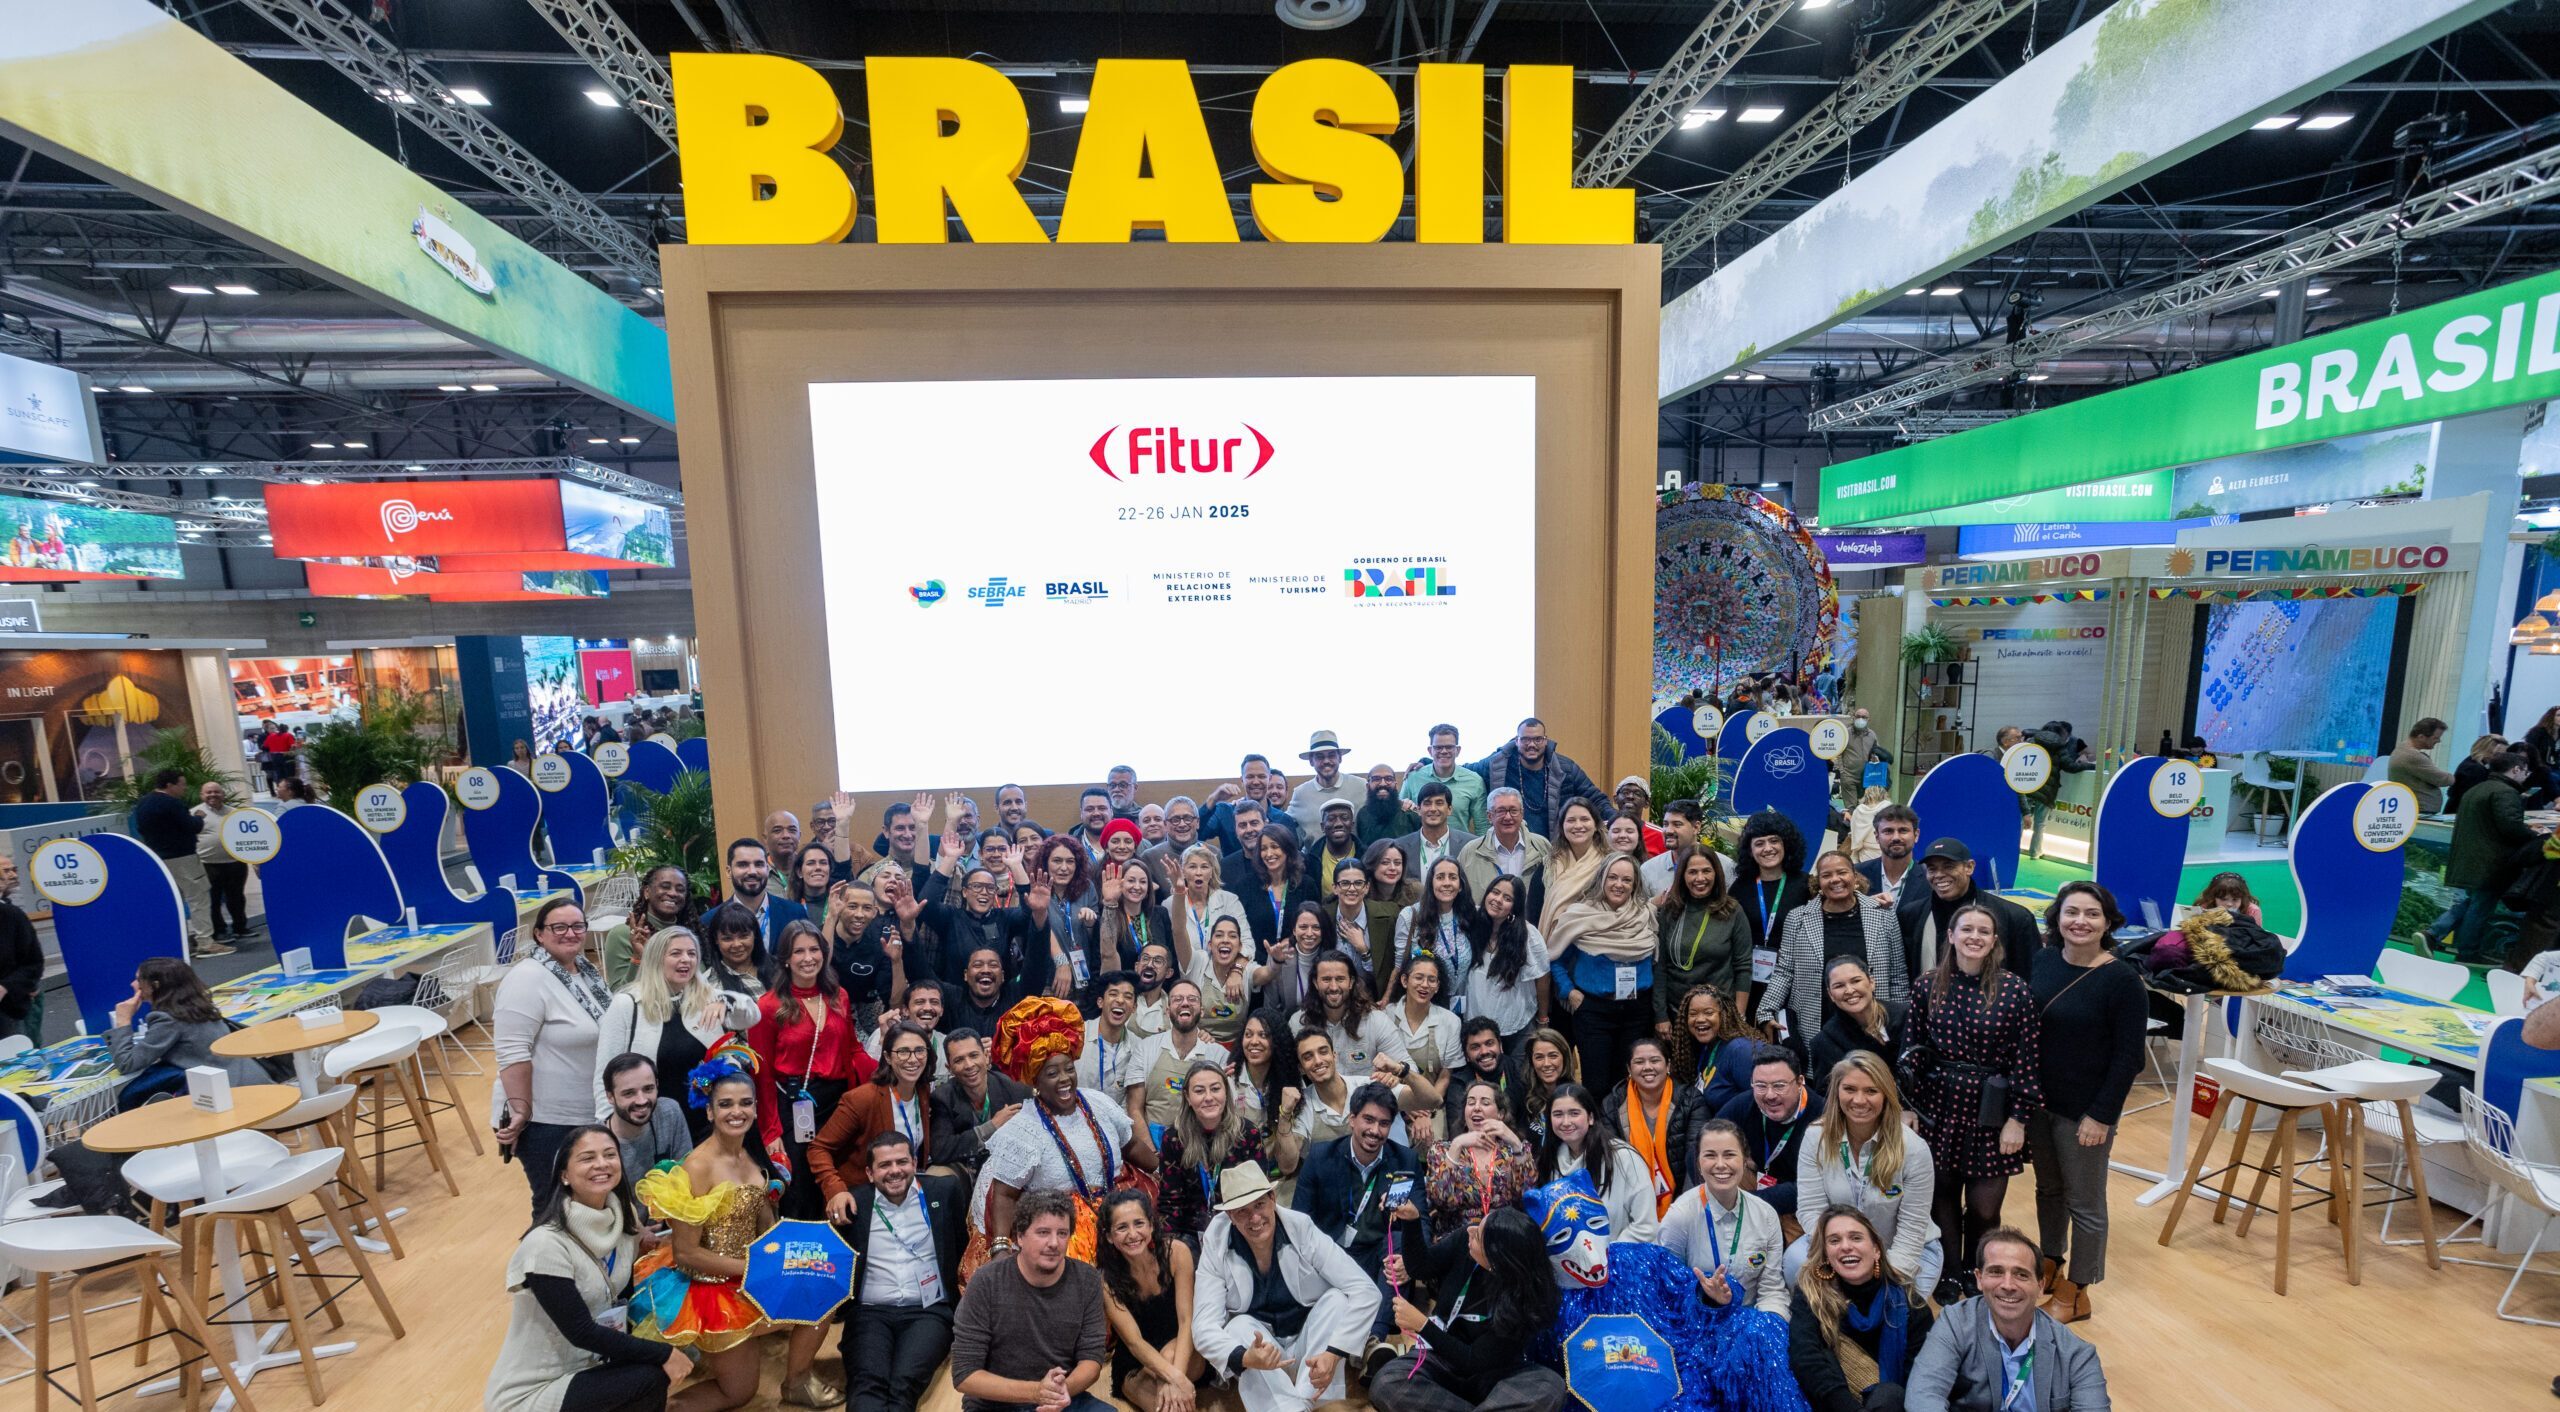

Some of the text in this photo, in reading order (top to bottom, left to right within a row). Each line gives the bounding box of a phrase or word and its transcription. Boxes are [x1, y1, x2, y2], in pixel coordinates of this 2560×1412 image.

[671, 53, 1634, 246] BRASIL
[2255, 293, 2560, 430] BRASIL
[7, 407, 70, 427] SUNSCAPE
[1836, 474, 1897, 499] VISITBRASIL.COM
[2228, 473, 2289, 491] ALTA FLORESTA
[2065, 484, 2153, 497] VISITBRASIL.COM
[1118, 505, 1249, 520] 22-26 JAN 2025
[380, 499, 454, 543] Perú
[2041, 533, 2050, 541] el
[2205, 546, 2449, 572] PERNAMBUCO
[1942, 553, 2101, 586] PERNAMBUCO
[1153, 572, 1214, 580] MINISTERIO
[1249, 575, 1309, 583] MINISTERIO
[1344, 567, 1456, 597] BRASIL
[968, 586, 1026, 598] SEBRAE
[1046, 581, 1109, 595] BRASIL
[1166, 583, 1231, 591] RELACIONES
[1280, 586, 1326, 594] TURISMO
[1168, 594, 1232, 602] EXTERIORES
[1982, 627, 2105, 641] PERNAMBUCO
[637, 645, 679, 656] KARISMA
[7, 687, 55, 698] IN LIGHT
[1704, 713, 1713, 721] 15
[1758, 719, 1769, 728] 16
[1823, 729, 1835, 738] 16
[606, 749, 617, 758] 10
[543, 761, 556, 771] 09
[2022, 755, 2037, 766] 17
[469, 776, 484, 786] 08
[2169, 772, 2186, 785] 18
[371, 795, 387, 806] 07
[2378, 797, 2399, 814] 19
[239, 820, 259, 833] 06
[54, 853, 79, 869] 05
[43, 879, 84, 887] SEBASTIÃO
